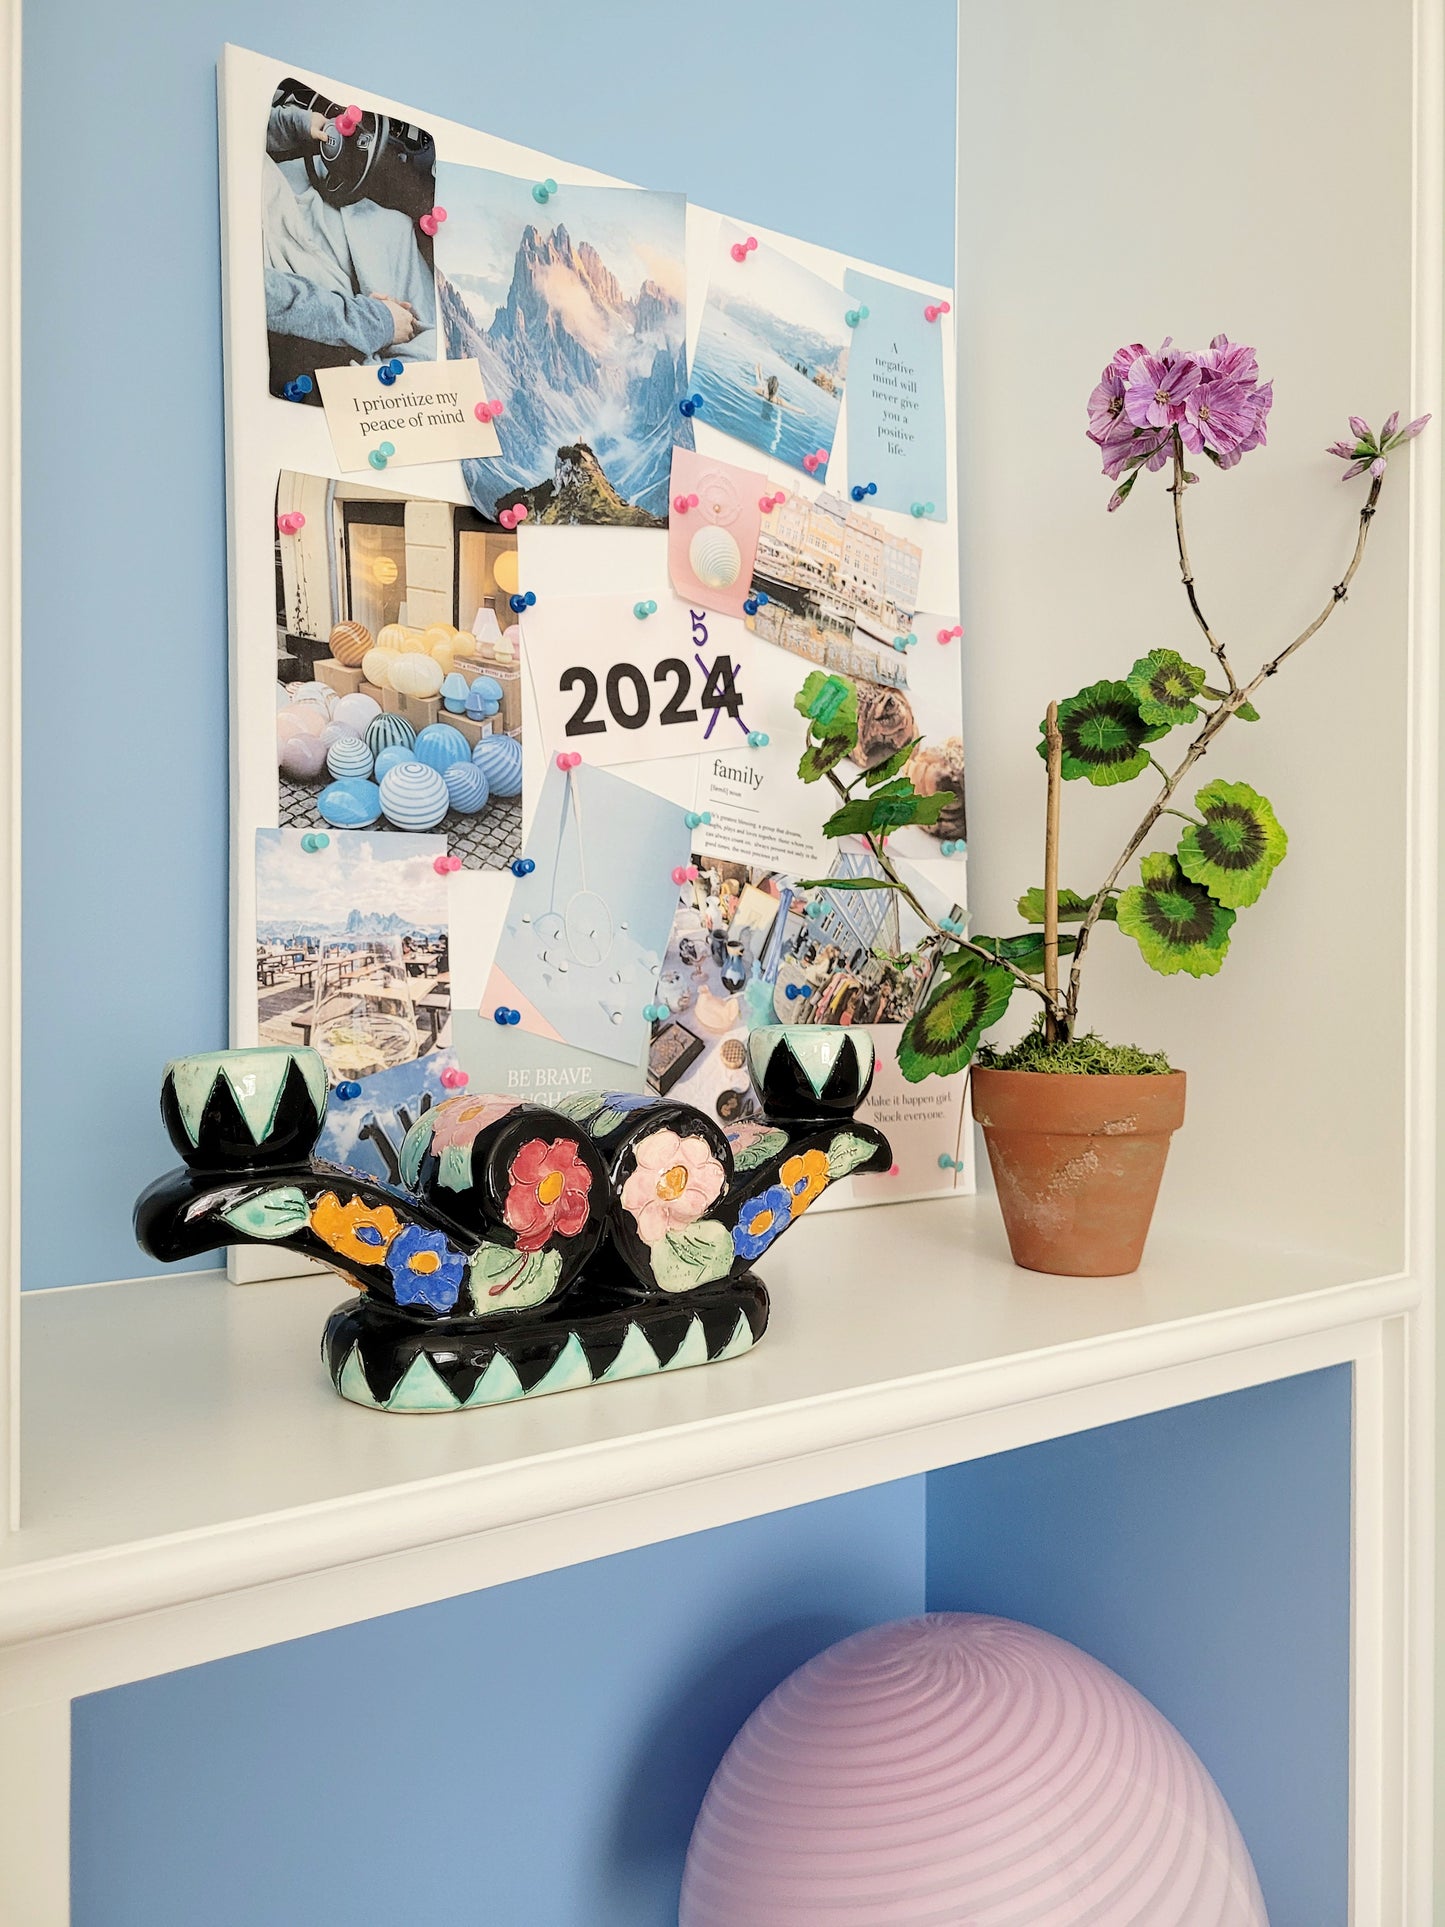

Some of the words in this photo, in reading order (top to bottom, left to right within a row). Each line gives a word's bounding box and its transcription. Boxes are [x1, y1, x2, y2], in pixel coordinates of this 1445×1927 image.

[892, 342, 899, 354] A
[875, 357, 915, 376] negative
[872, 372, 898, 388] mind
[900, 380, 918, 394] will
[353, 397, 360, 412] I
[362, 392, 434, 415] prioritize
[436, 392, 458, 407] my
[872, 389, 898, 404] never
[900, 396, 919, 410] give
[360, 417, 406, 436] peace
[408, 412, 423, 427] of
[427, 409, 465, 425] mind
[882, 410, 900, 422] you
[903, 416, 908, 424] a
[877, 425, 915, 441] positive
[887, 442, 907, 457] life.
[689, 609, 709, 647] 5
[559, 655, 744, 737] 2024
[713, 759, 764, 790] family
[507, 1069, 530, 1088] BE
[536, 1066, 592, 1086] BRAVE
[865, 1095, 891, 1107] Make
[893, 1095, 899, 1105] it
[902, 1094, 934, 1107] happen
[873, 1111, 901, 1123] Shock
[903, 1110, 945, 1122] everyone.
